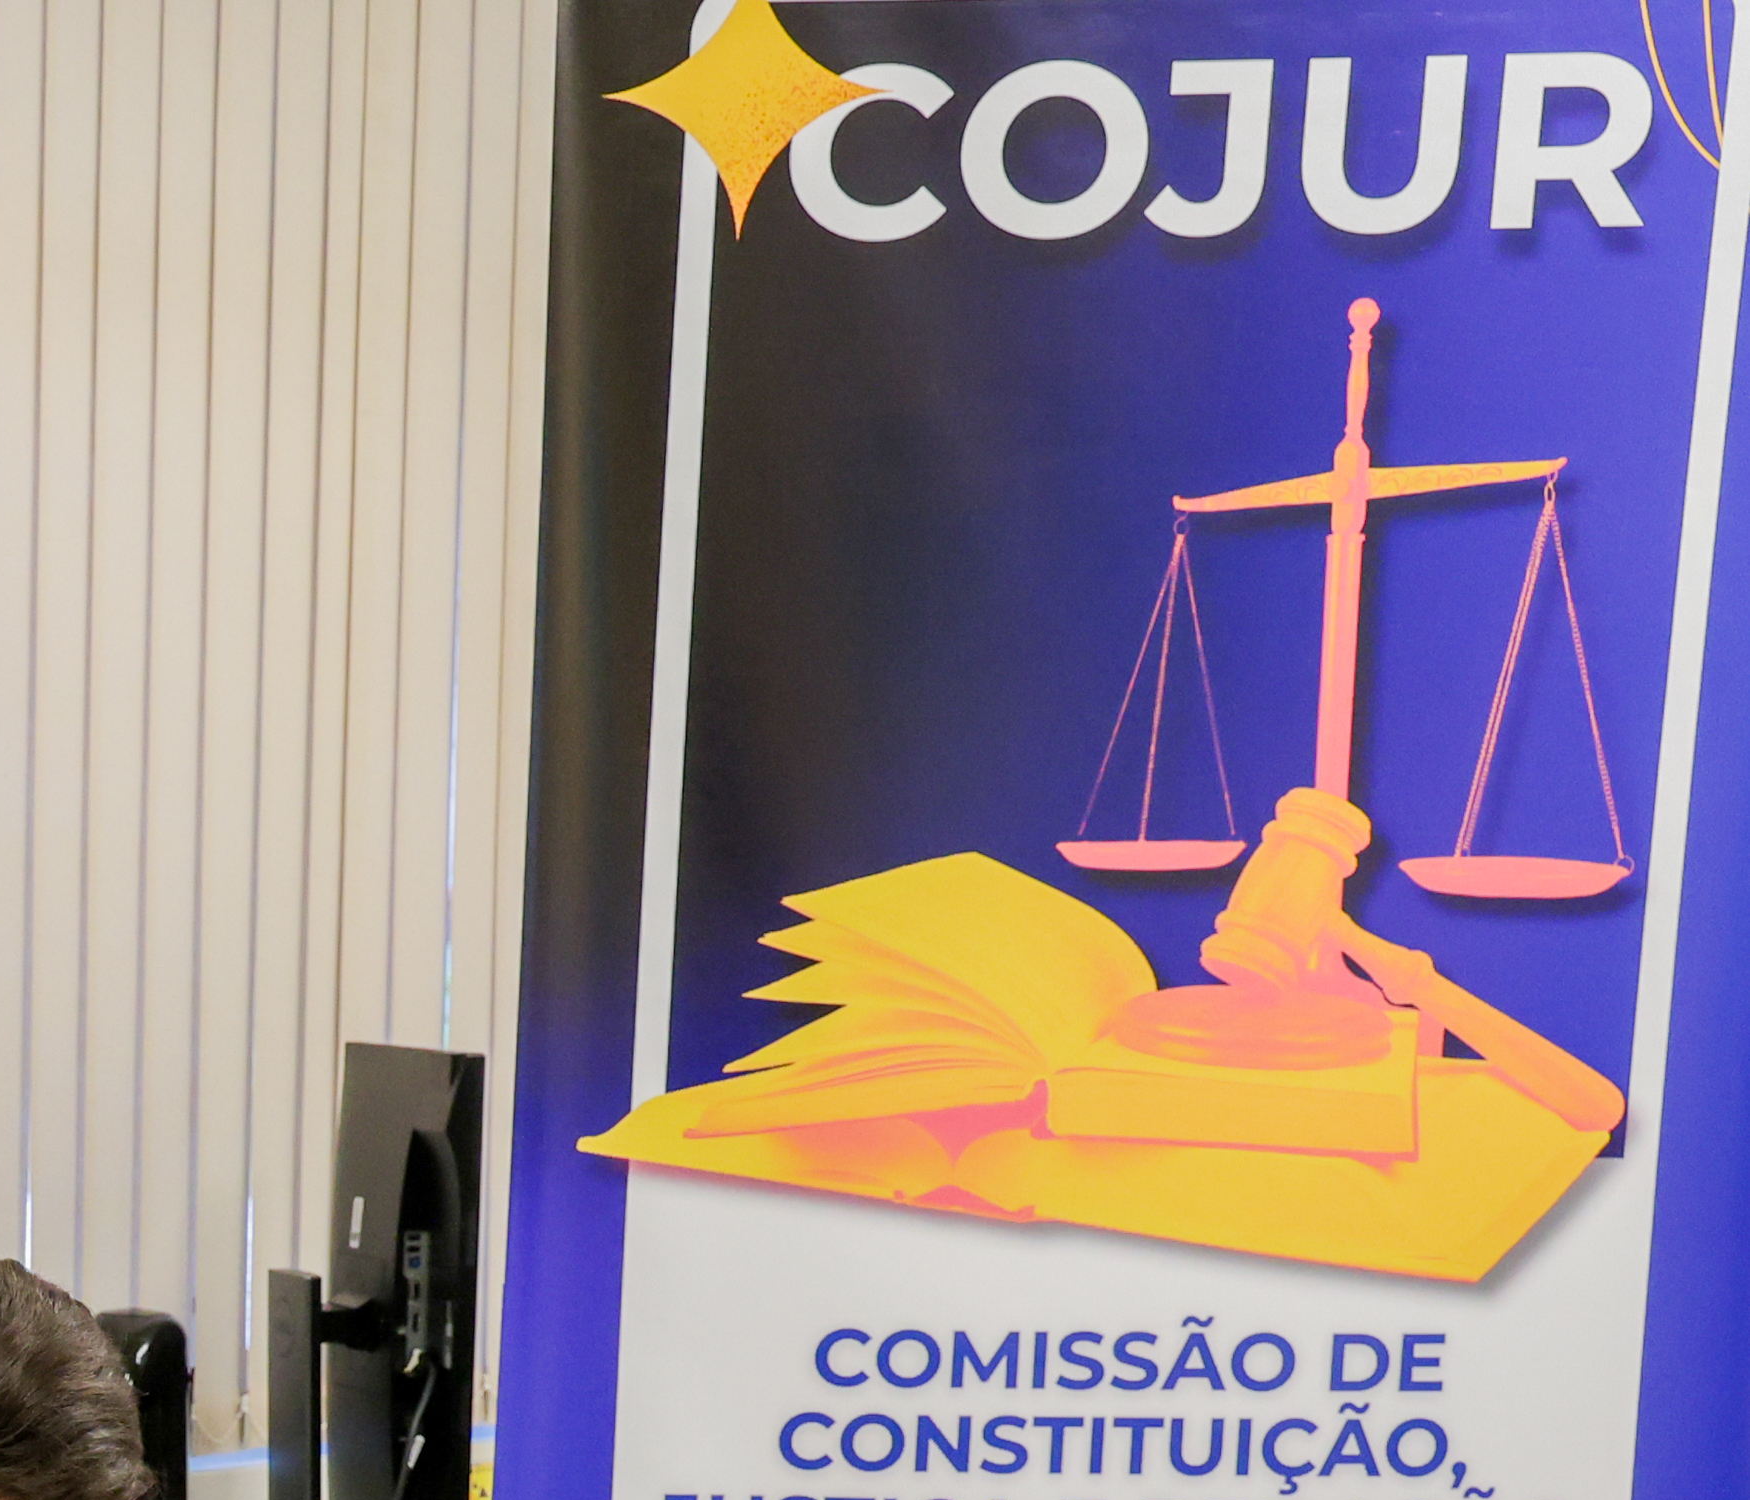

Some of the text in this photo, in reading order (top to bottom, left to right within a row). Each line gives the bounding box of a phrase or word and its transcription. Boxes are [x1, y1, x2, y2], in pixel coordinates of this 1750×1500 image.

[790, 51, 1654, 242] COJUR
[814, 1316, 1447, 1392] COMISSÃO DE
[779, 1402, 1468, 1495] CONSTITUIÇÃO,
